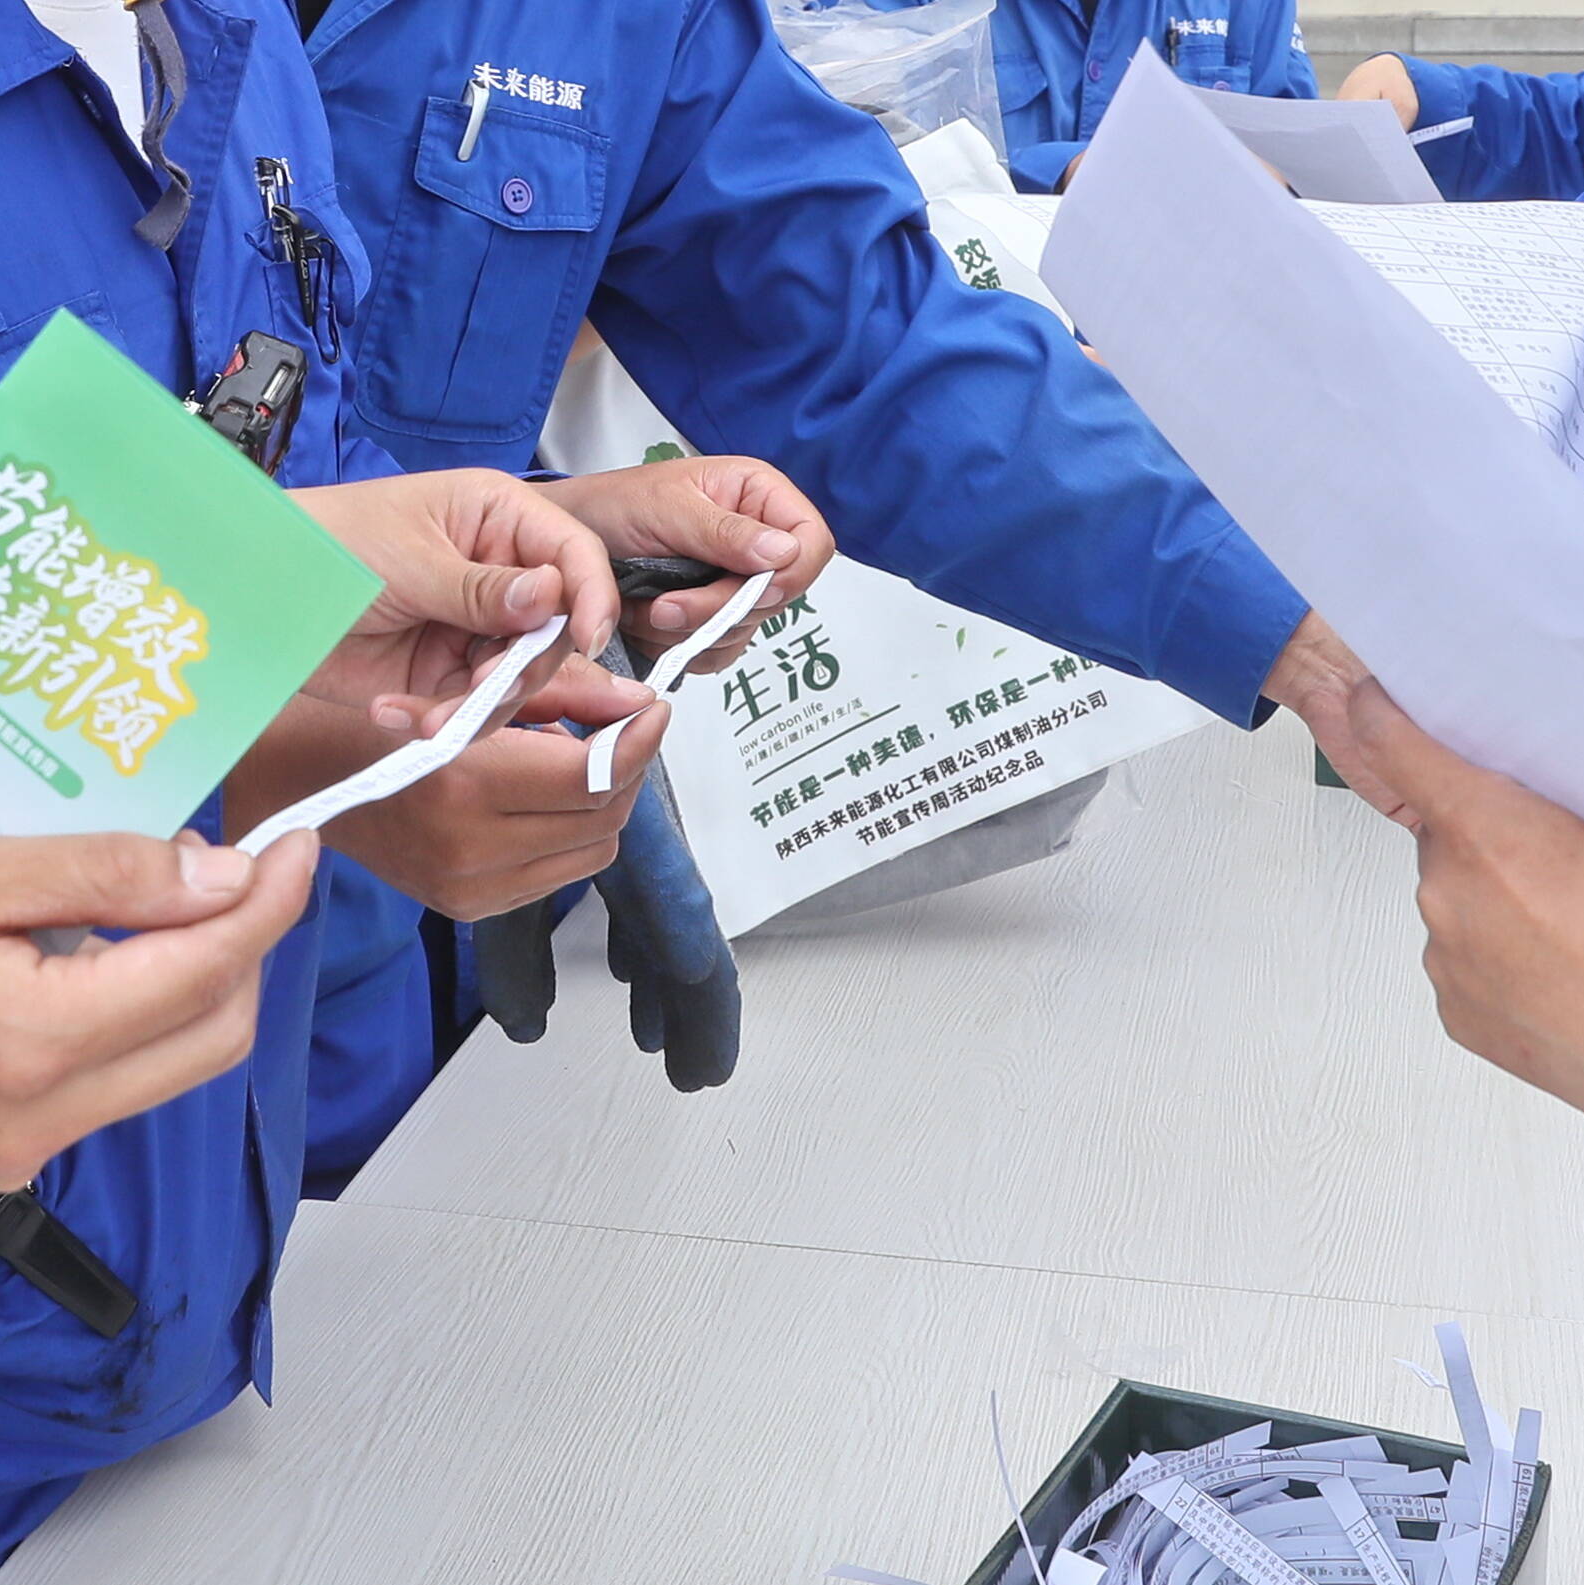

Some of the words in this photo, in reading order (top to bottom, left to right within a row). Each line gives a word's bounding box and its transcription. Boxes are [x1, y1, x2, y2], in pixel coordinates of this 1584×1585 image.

[472, 61, 588, 111] 未来能源
[723, 623, 840, 739] 生活
[739, 737, 759, 758] low
[760, 712, 803, 743] carbon
[802, 700, 825, 720] life
[774, 688, 1109, 862] 陕西未来能源化工有限公司煤制油分公司
[854, 749, 1045, 848] 节能宣传周活动纪念品
[1173, 1495, 1189, 1510] 22
[1351, 1526, 1366, 1541] 17
[1187, 1507, 1286, 1585] 及中级以上技术职称的
